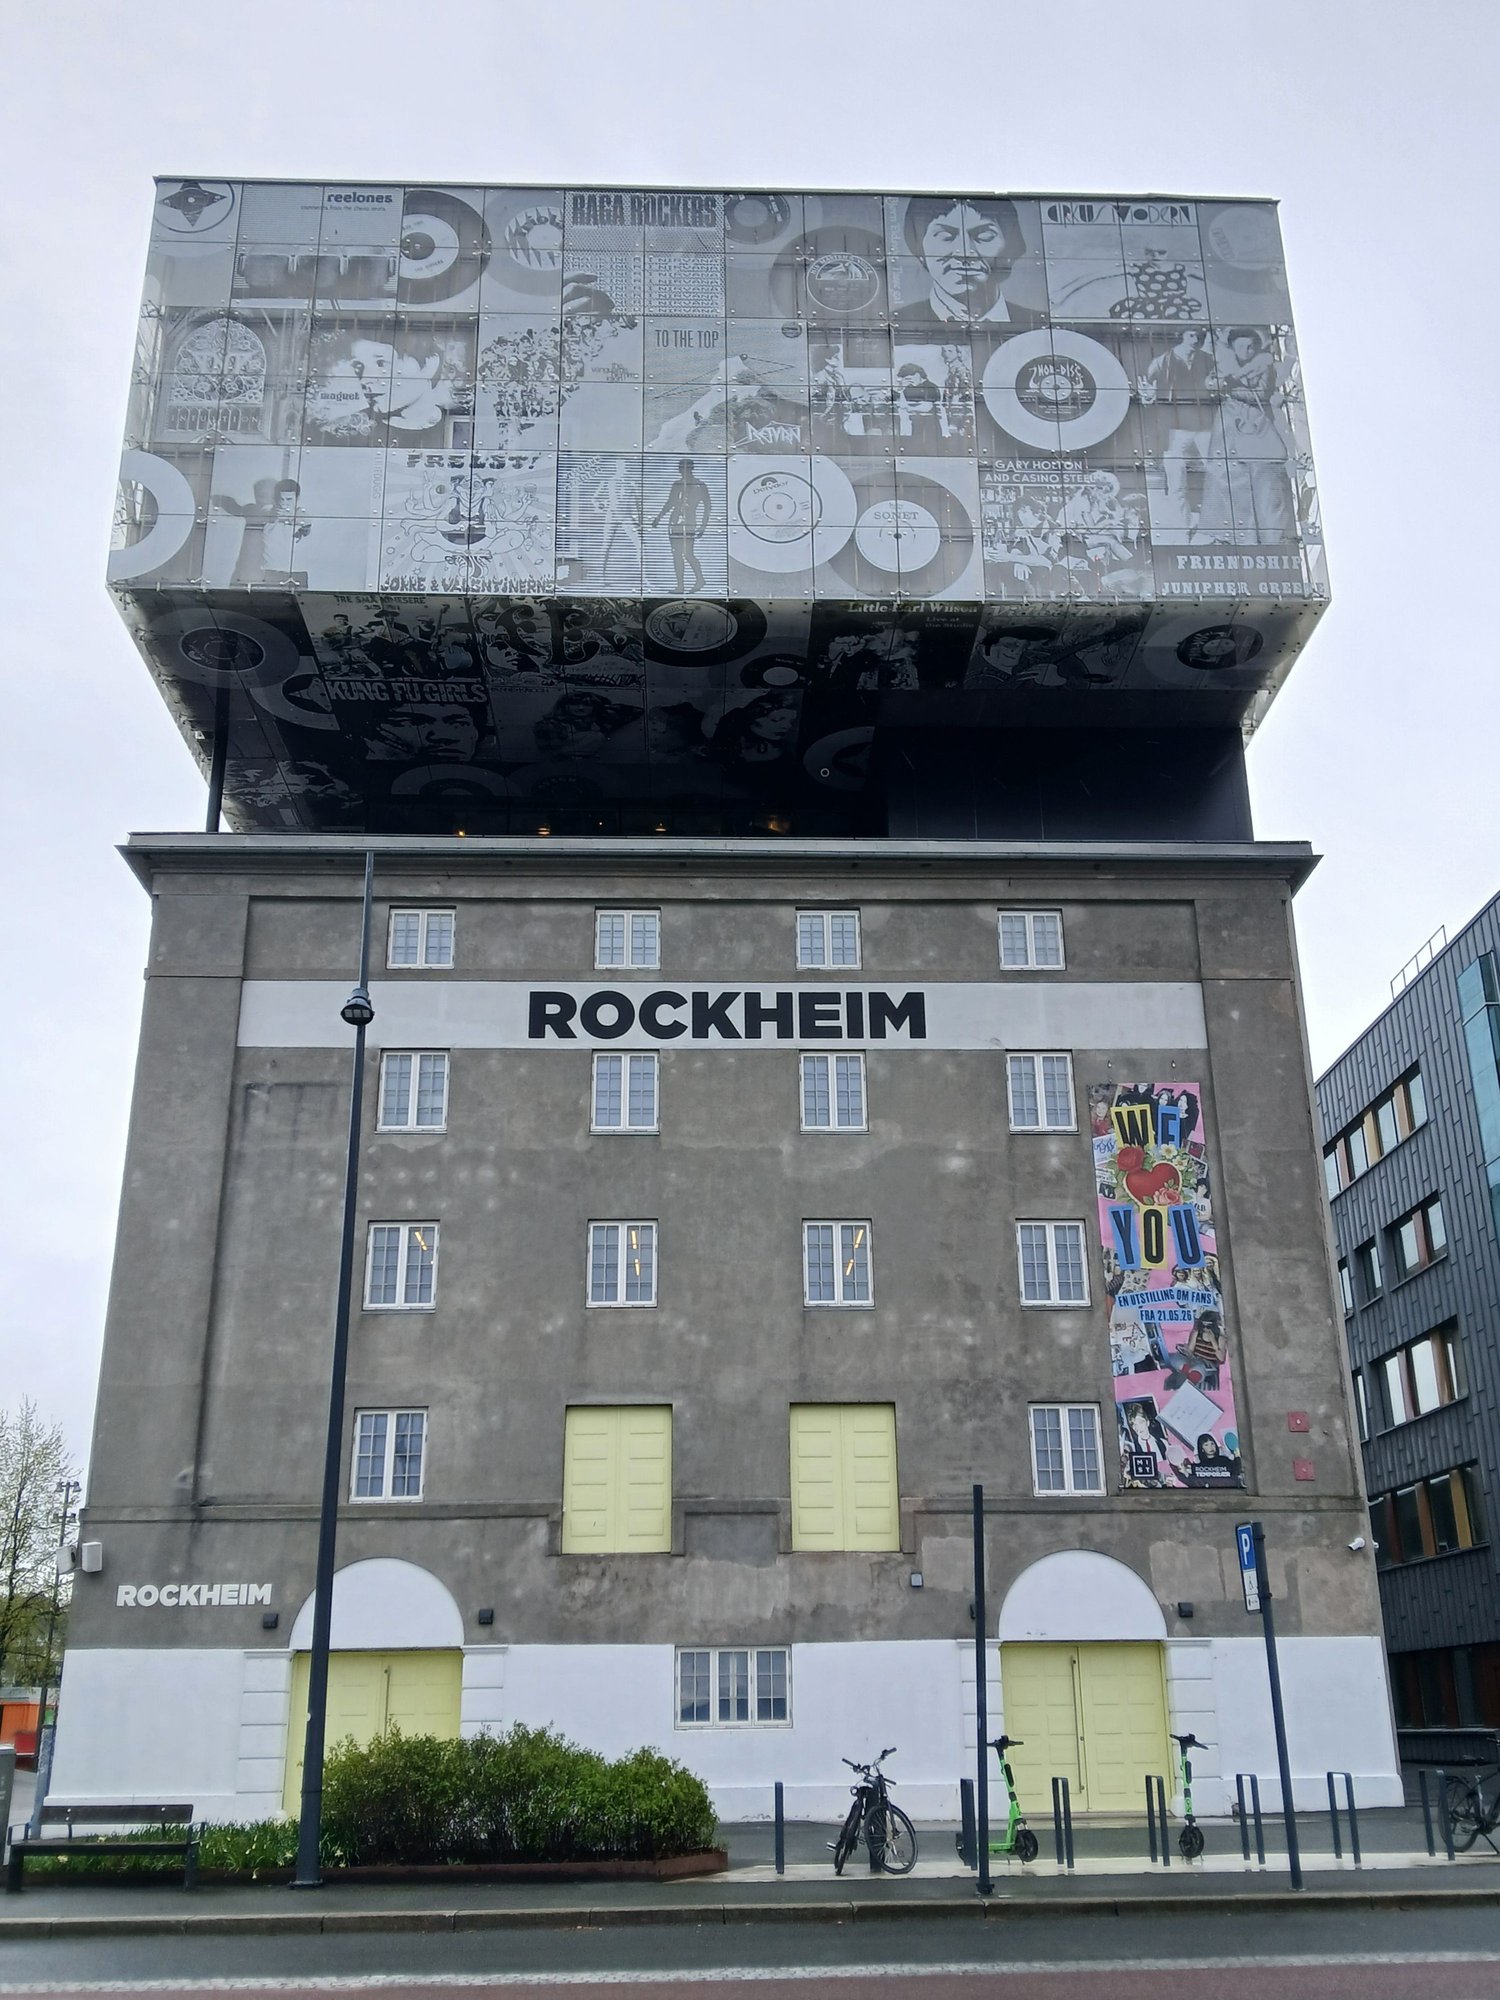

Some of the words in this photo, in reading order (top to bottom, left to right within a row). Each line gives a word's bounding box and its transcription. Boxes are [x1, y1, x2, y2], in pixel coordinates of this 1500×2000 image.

[327, 192, 393, 203] reelones
[572, 194, 625, 227] RAGA
[630, 195, 716, 228] ROCKERS
[1111, 204, 1191, 225] MODERN
[655, 329, 669, 348] TO
[673, 330, 694, 348] THE
[697, 330, 720, 349] TOP
[171, 415, 259, 424] INTUITION
[407, 450, 542, 470] FRELST!
[995, 460, 1029, 472] GARY
[1033, 460, 1083, 470] HOLTON
[984, 474, 1009, 482] AND
[1013, 474, 1059, 483] CASINO
[874, 511, 919, 520] SONET
[1176, 555, 1302, 570] FRIENDSHIP
[430, 577, 439, 591] &
[1161, 582, 1250, 595] JUNIPHER
[847, 602, 891, 614] Little
[892, 602, 924, 613] Earl
[929, 602, 978, 614] Wilson
[327, 682, 390, 702] KUNG
[391, 683, 422, 702] FU
[423, 682, 489, 703] GIRLS
[528, 990, 927, 1039] ROCKHEIM
[1115, 1110, 1177, 1147] WE
[1111, 1209, 1201, 1265] YOU
[1118, 1295, 1130, 1307] EN
[1130, 1289, 1175, 1306] UTSTILLING
[1176, 1289, 1189, 1303] OM
[1191, 1291, 1212, 1304] FANS
[1140, 1309, 1155, 1321] FRA
[1158, 1309, 1193, 1322] 21.05.26
[1241, 1533, 1251, 1566] P
[116, 1583, 273, 1607] ROCKHEIM
